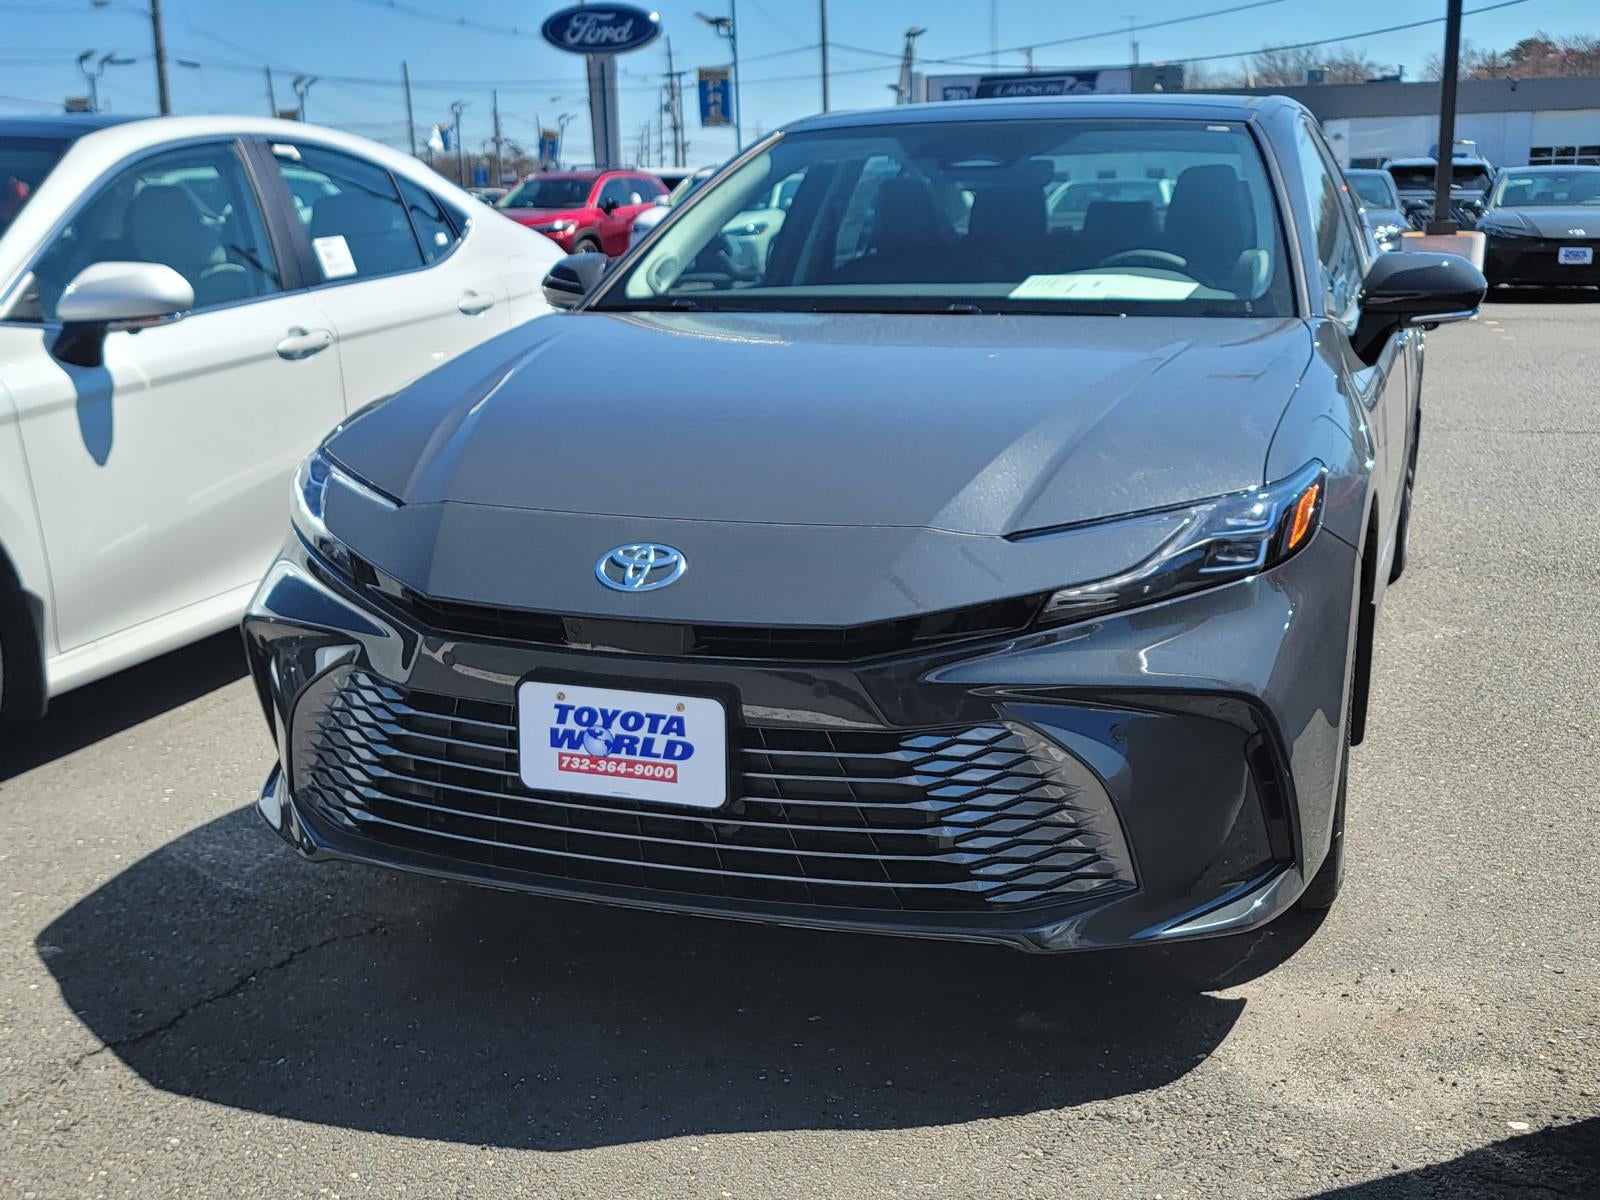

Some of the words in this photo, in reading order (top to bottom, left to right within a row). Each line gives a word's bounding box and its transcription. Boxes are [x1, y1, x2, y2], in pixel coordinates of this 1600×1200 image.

[564, 12, 633, 44] Ford
[554, 703, 686, 737] TOYOTA
[550, 726, 694, 761] WORLD
[561, 756, 675, 779] 732-364-9000
